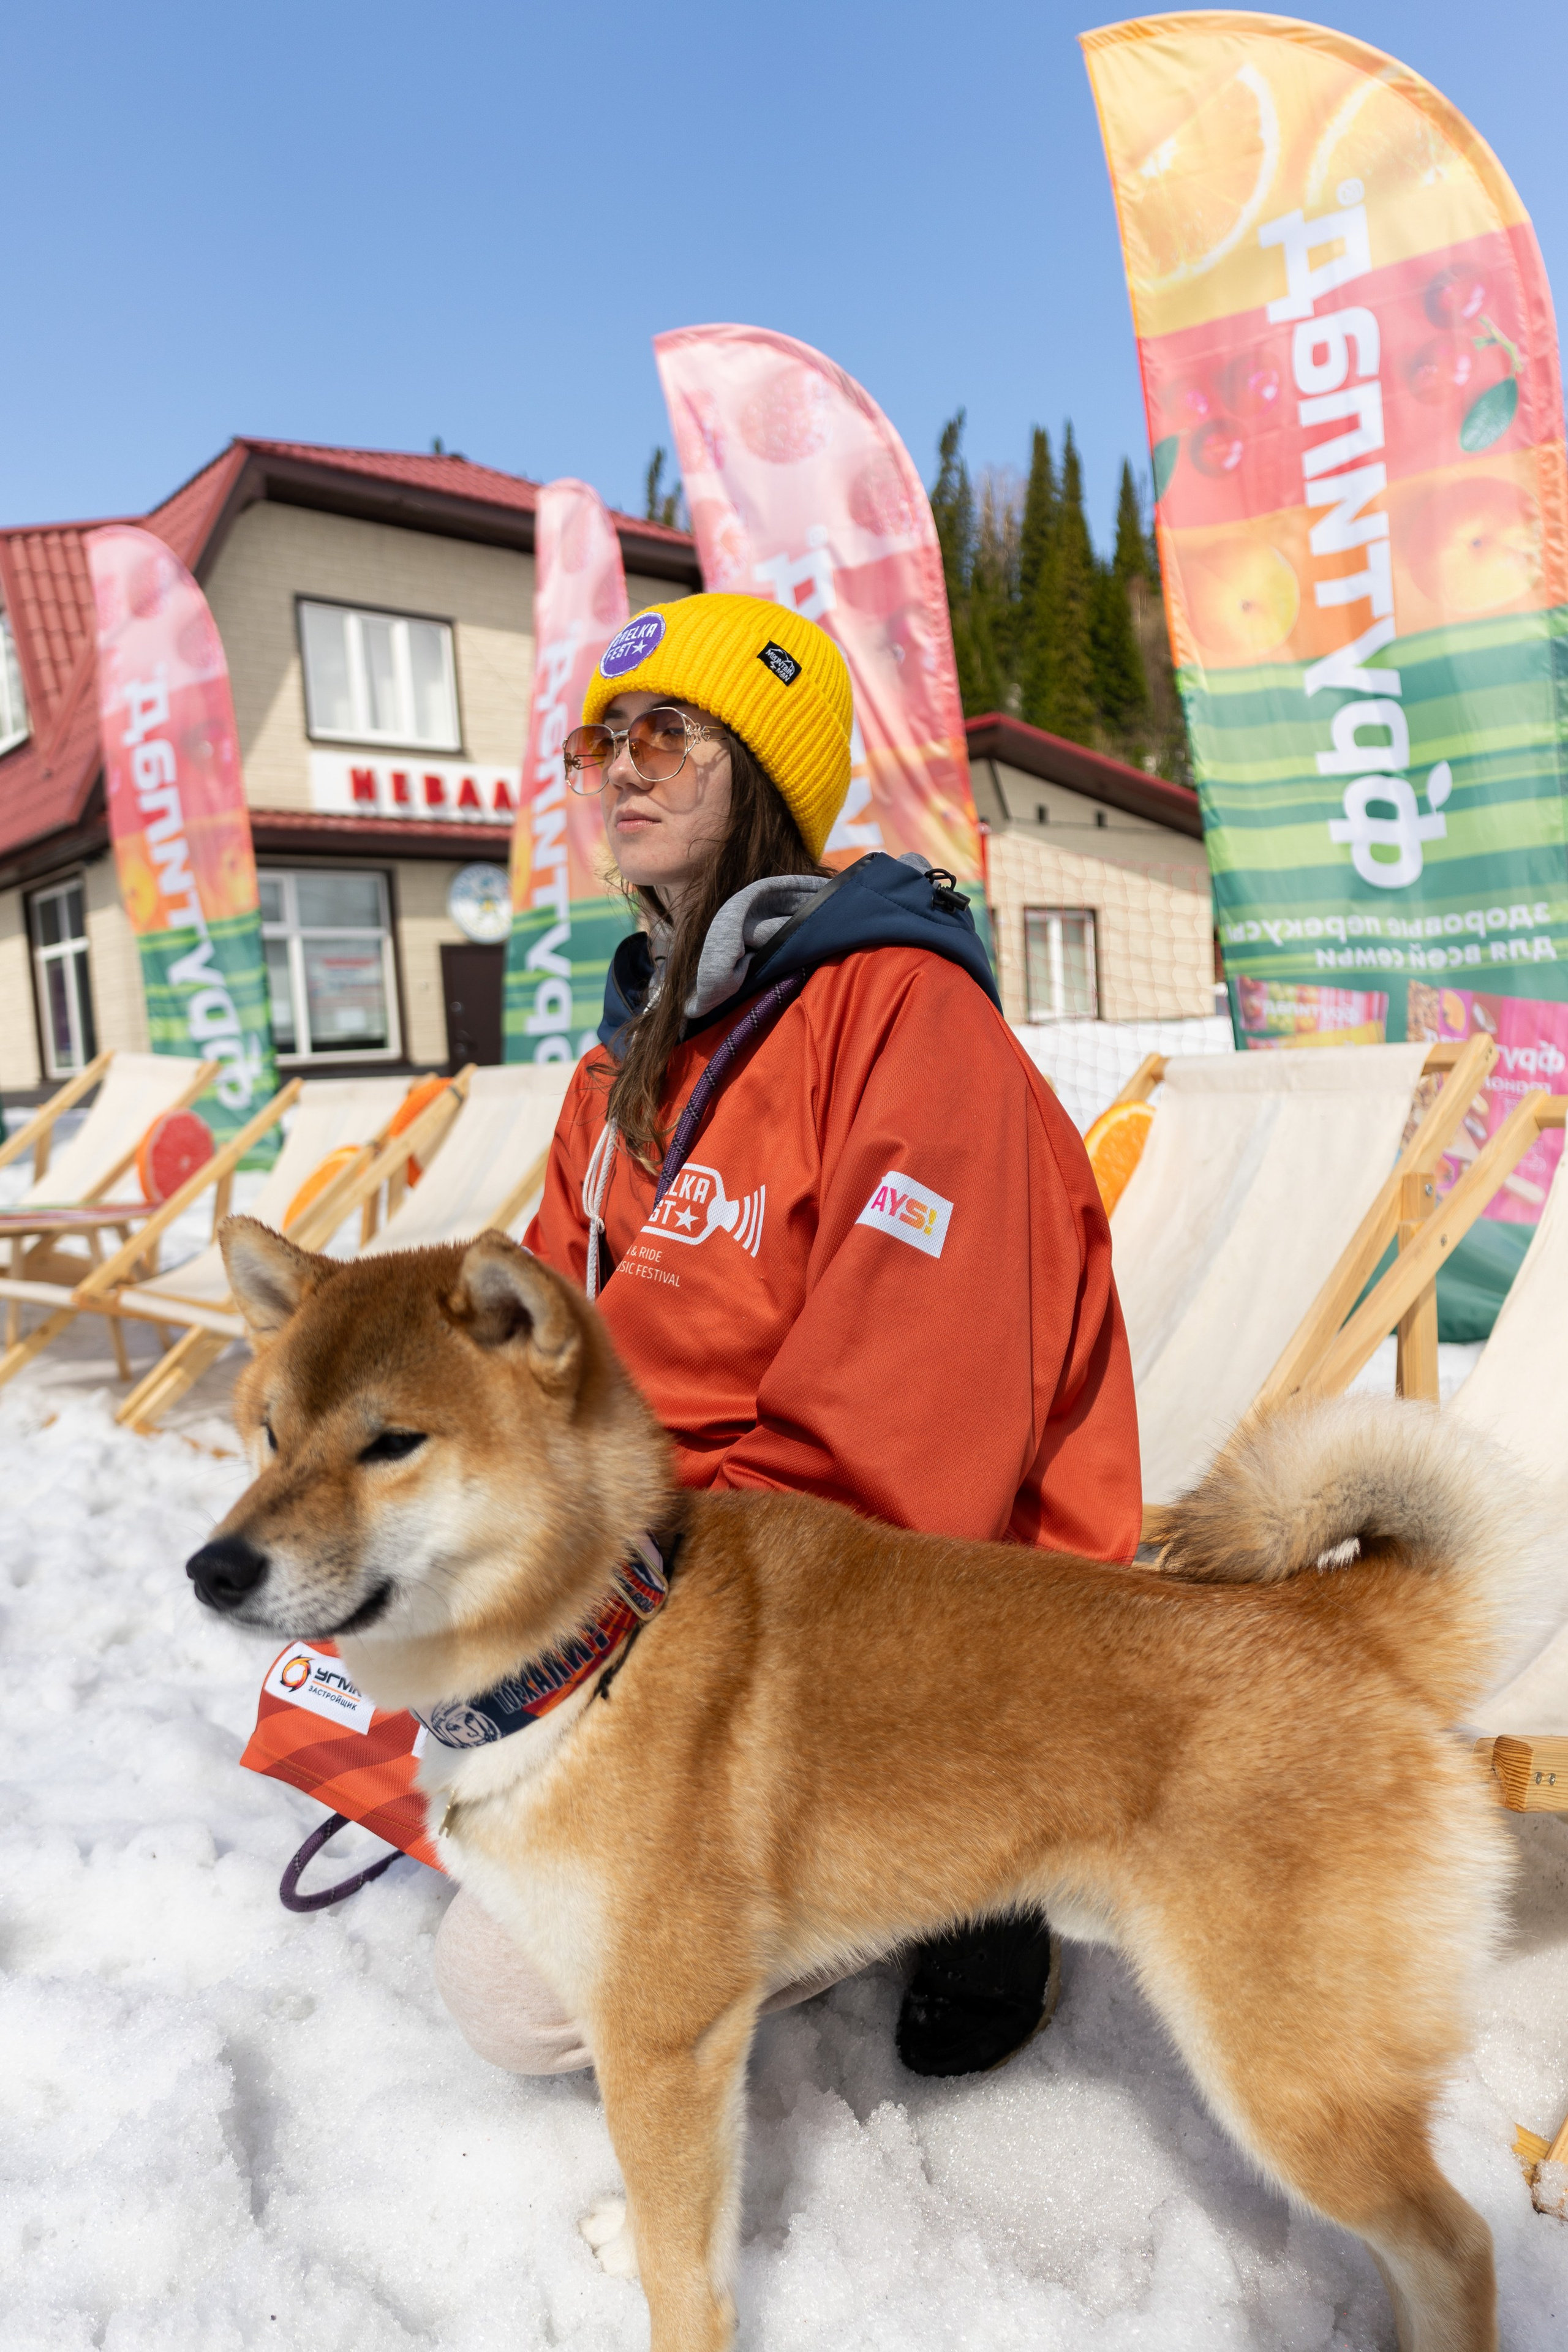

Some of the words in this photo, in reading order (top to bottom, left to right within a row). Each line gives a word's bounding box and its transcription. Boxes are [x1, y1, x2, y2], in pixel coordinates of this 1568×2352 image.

[605, 641, 635, 665] FEST
[765, 649, 794, 677] MOUNTAIN
[775, 667, 790, 682] MAN
[665, 1173, 710, 1204] LKA
[870, 1185, 937, 1236] AYS!
[630, 1245, 638, 1256] &
[639, 1246, 662, 1262] RIDE
[636, 1264, 680, 1287] FESTIVAL
[308, 1685, 357, 1711] ЗАСТРОЙЩИК
